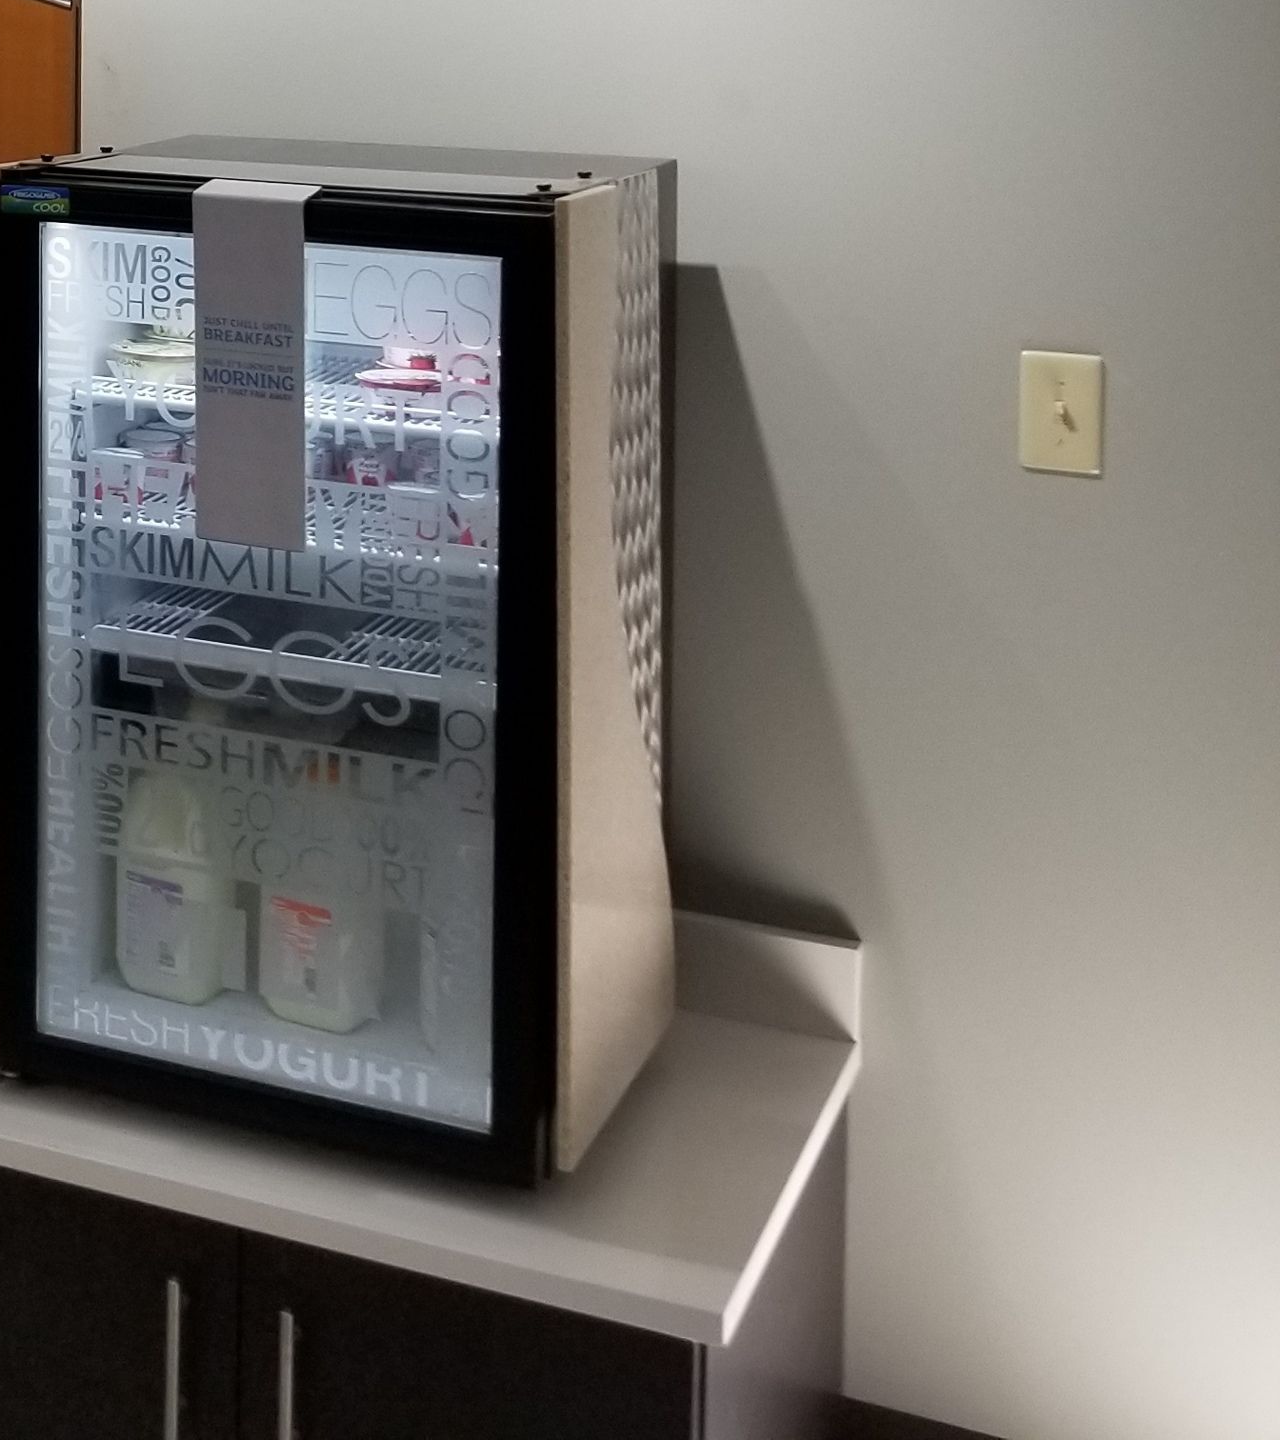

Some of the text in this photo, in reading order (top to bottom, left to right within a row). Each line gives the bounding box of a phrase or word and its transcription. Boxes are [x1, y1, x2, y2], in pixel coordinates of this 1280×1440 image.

[33, 202, 67, 213] COOL
[151, 246, 171, 321] GOOD
[313, 261, 492, 350] EGGS
[203, 327, 294, 348] BREAKFAST
[203, 367, 295, 392] MORNING
[49, 418, 87, 459] 2%
[91, 526, 193, 580] SKIM
[199, 541, 356, 603] MILK
[91, 713, 254, 779] FRESH
[262, 746, 437, 800] MILK
[92, 763, 124, 847] 100%
[48, 984, 435, 1107] FRESH YOGURT
